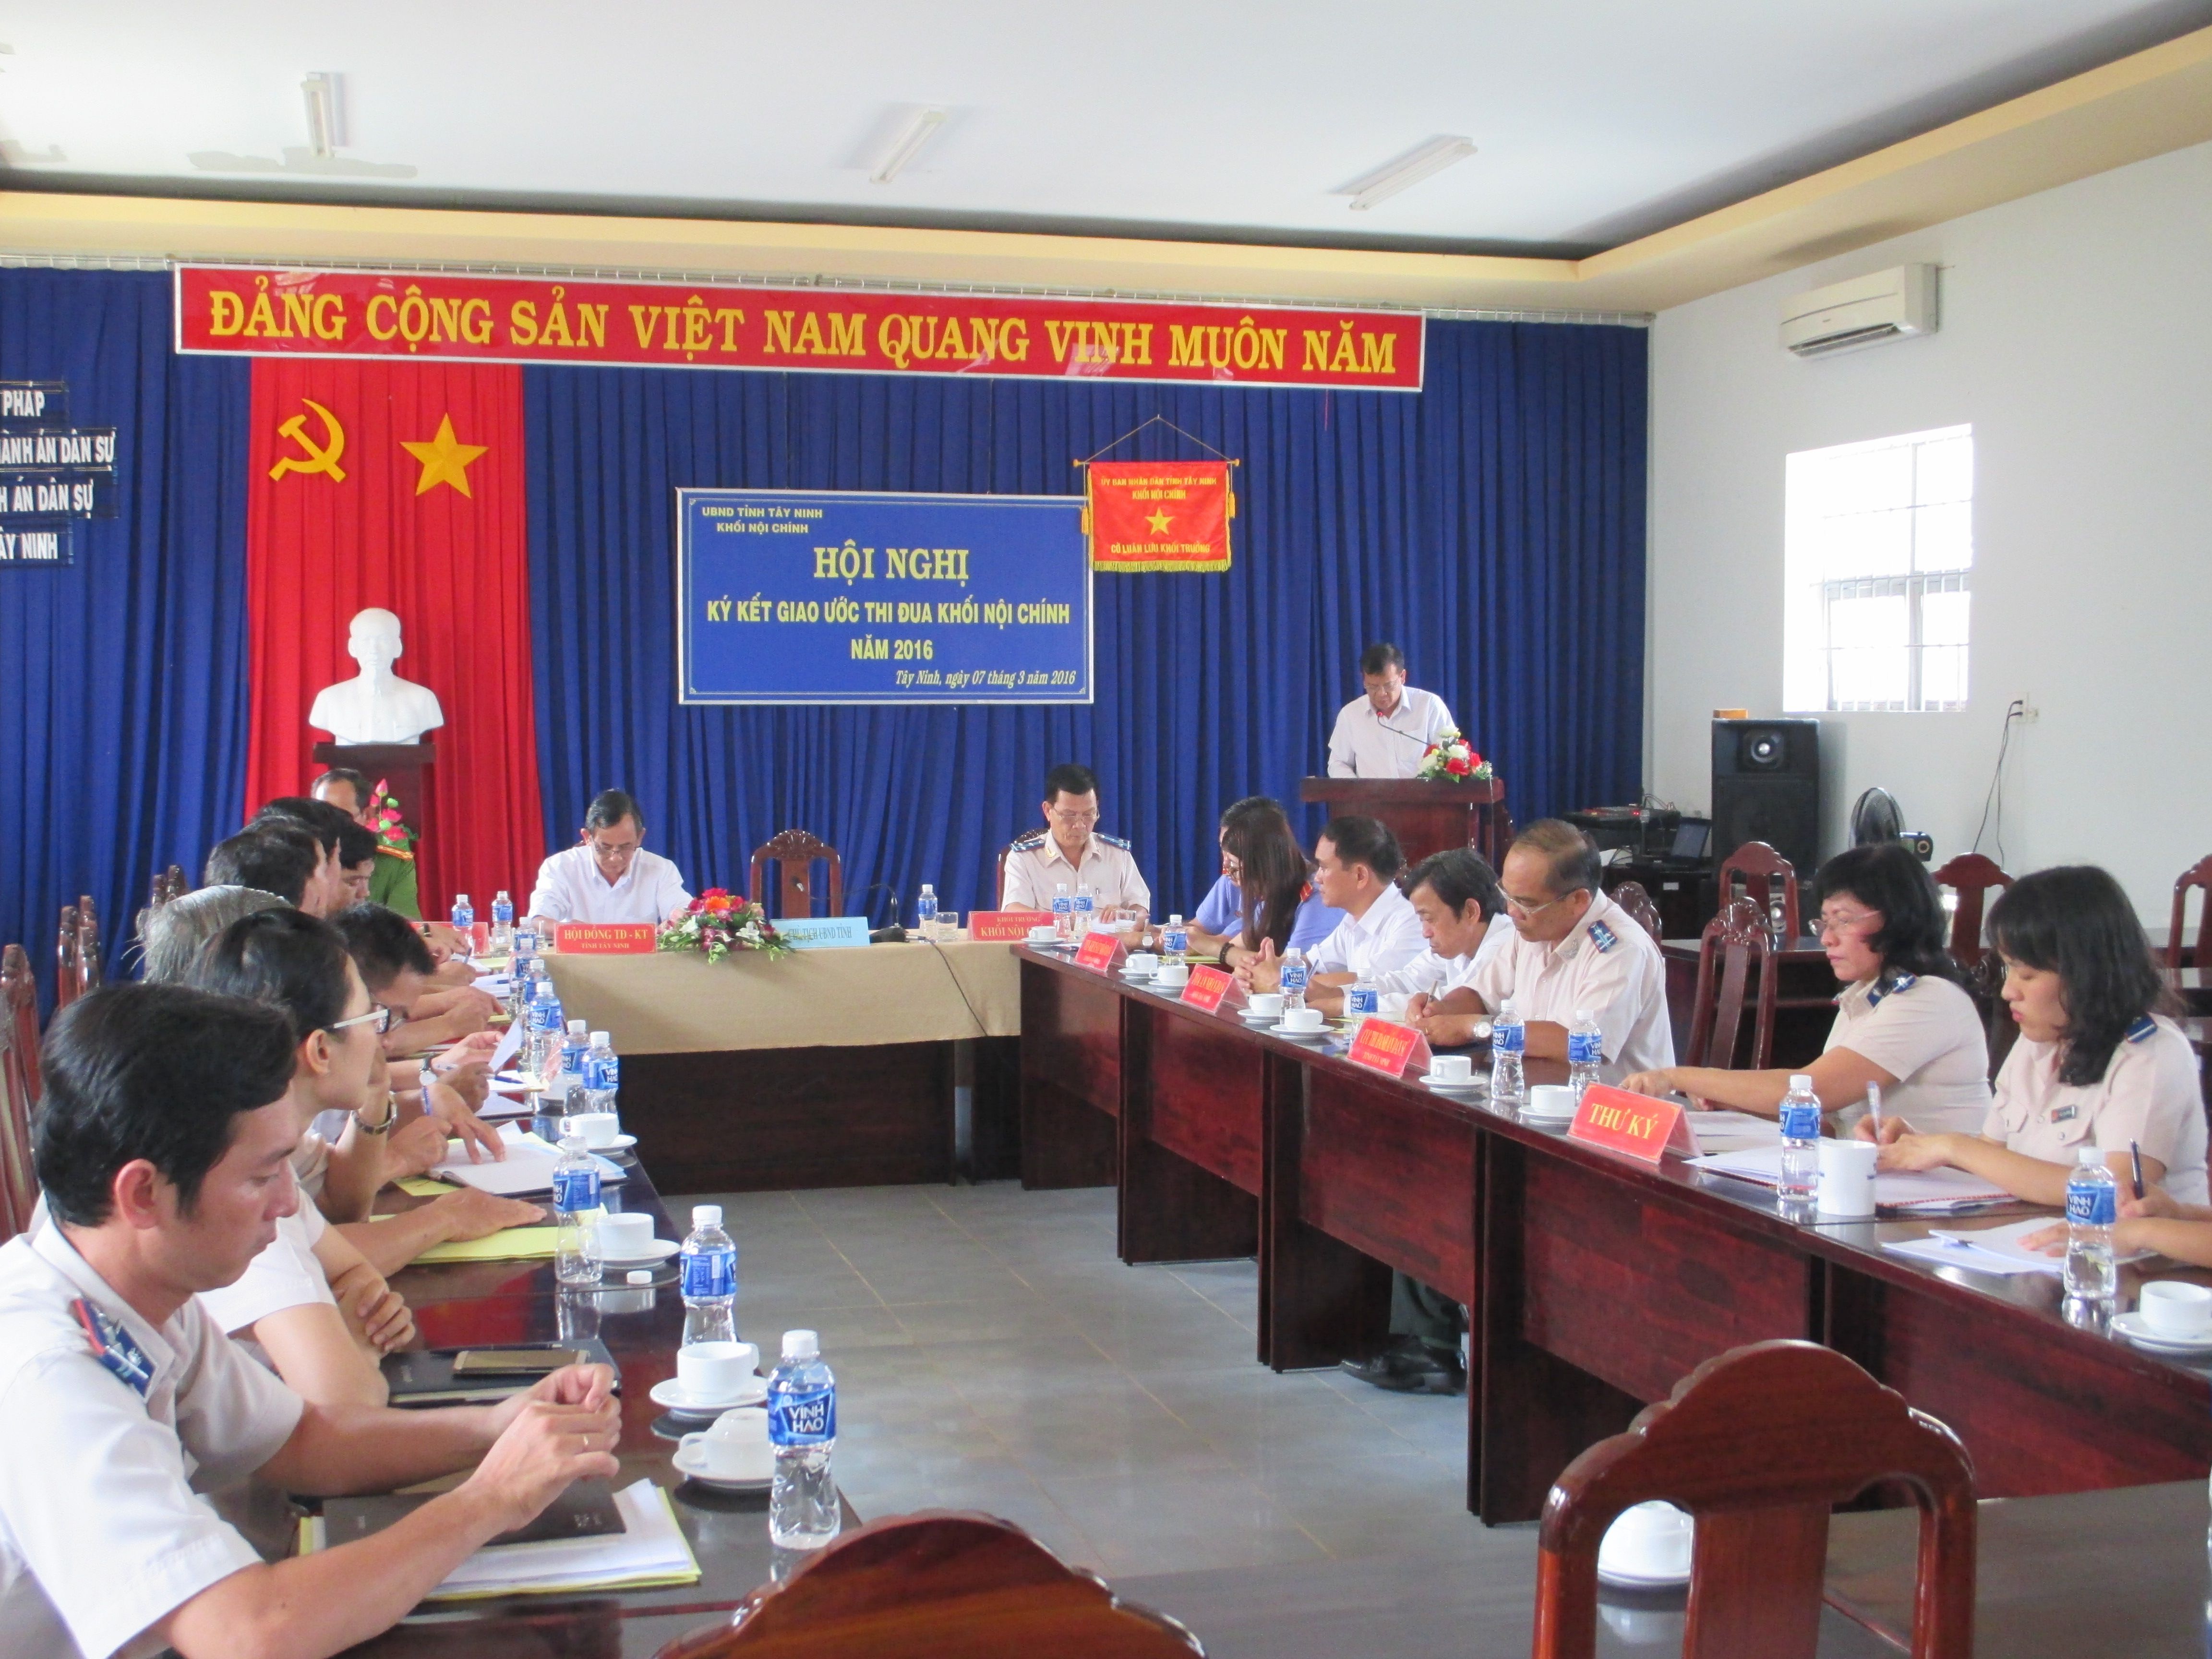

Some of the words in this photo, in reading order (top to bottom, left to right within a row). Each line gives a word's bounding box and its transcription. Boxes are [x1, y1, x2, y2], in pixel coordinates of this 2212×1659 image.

[210, 275, 347, 339] ĐẢNG
[367, 284, 493, 352] CỘNG
[510, 286, 609, 348] SẢN
[628, 294, 745, 361] VIỆT
[764, 310, 867, 356] NAM
[878, 313, 1030, 369] QUANG
[1045, 321, 1152, 365] VINH
[1169, 315, 1287, 370] MUÔN
[1302, 320, 1396, 373] NĂM
[60, 428, 91, 463] DÂN
[12, 475, 34, 512] ÁN
[38, 476, 69, 511] DÂN
[72, 478, 94, 519] SỰ
[702, 507, 734, 517] UBND
[737, 505, 765, 517] TỈNH
[768, 506, 791, 518] TÂY
[794, 509, 822, 518] NINH
[717, 519, 745, 532] KHỐI
[749, 521, 768, 534] NỘI
[772, 521, 808, 533] CHÍNH
[21, 533, 58, 559] NINH
[814, 539, 874, 586] HỘI
[886, 548, 969, 587] NGHỊ
[708, 595, 732, 621] KÝ
[737, 592, 772, 622] KẾT
[777, 601, 819, 622] GIAO
[825, 596, 859, 622] ƯỚC
[865, 602, 892, 623] THI
[898, 602, 933, 623] ĐUA
[938, 594, 978, 624] KHỐI
[984, 598, 1012, 629] NỘI
[1018, 598, 1070, 624] CHÍNH
[851, 634, 888, 660] NĂM
[894, 639, 933, 660] 2016
[896, 670, 914, 690] Tây
[916, 670, 941, 686] Ninh,
[945, 670, 969, 689] ngày
[973, 671, 985, 685] 07
[988, 670, 1014, 688] tháng
[1018, 671, 1024, 685] 3
[1028, 670, 1048, 685] năm
[1051, 670, 1076, 685] 2016
[565, 926, 581, 941] HỘI
[584, 925, 612, 940] ĐỒNG
[614, 929, 627, 939] TĐ
[635, 929, 648, 939] KT
[819, 927, 836, 940] UBND
[837, 923, 852, 938] TỈNH
[981, 923, 1005, 937] KHỐI
[1008, 925, 1025, 939] NỘI
[1588, 1103, 1631, 1131] THƯ
[1626, 1114, 1659, 1140] KÝ
